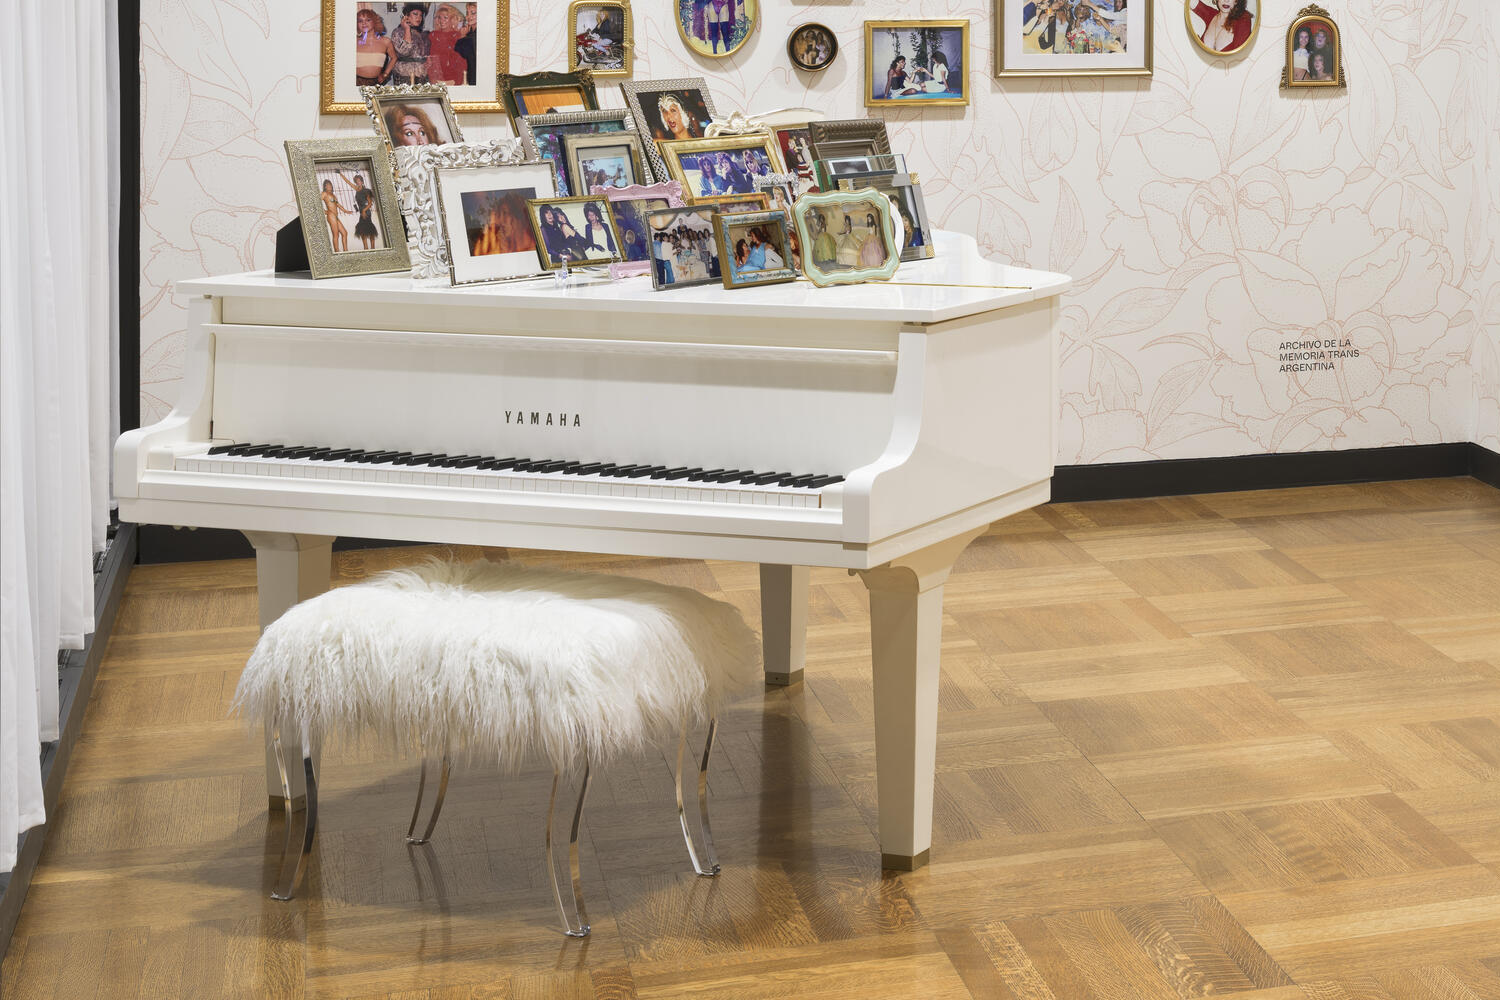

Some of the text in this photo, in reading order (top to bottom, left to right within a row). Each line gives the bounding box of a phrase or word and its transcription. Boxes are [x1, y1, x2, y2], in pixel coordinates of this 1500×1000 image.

[1279, 339, 1351, 350] ARCHIVO DE LA
[1279, 350, 1360, 361] MEMORIA TRANS
[1279, 362, 1335, 373] ARGENTINA
[505, 410, 581, 427] YAMAHA
